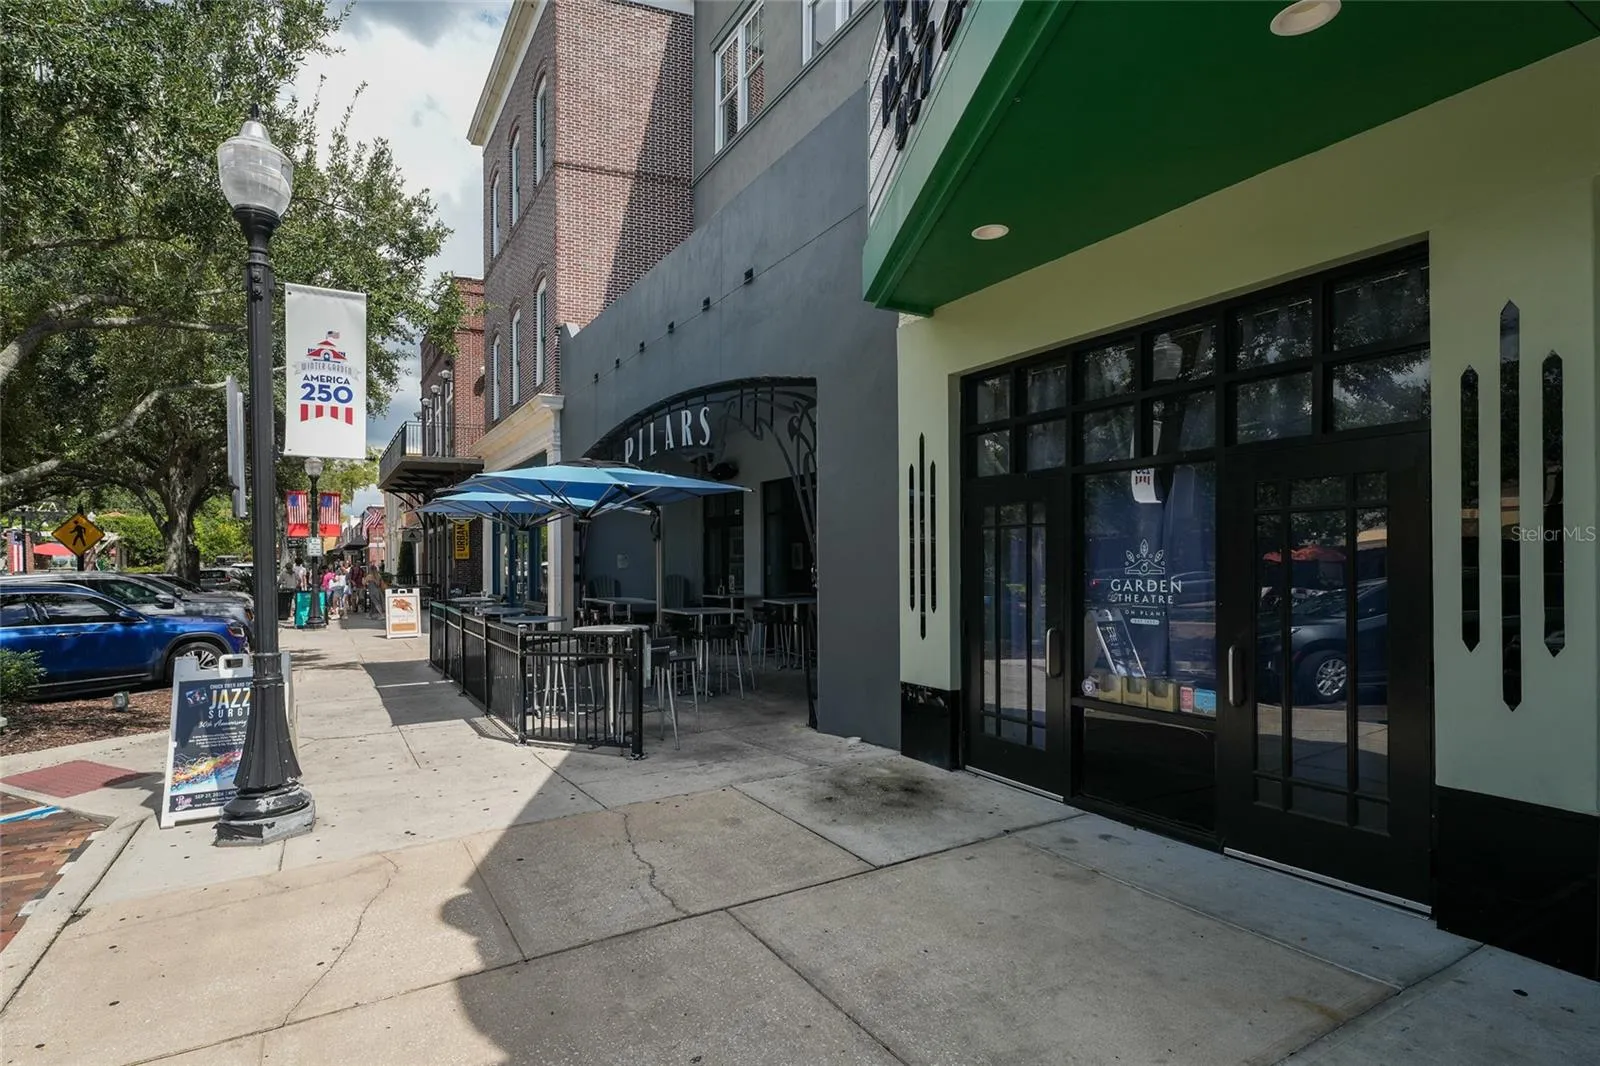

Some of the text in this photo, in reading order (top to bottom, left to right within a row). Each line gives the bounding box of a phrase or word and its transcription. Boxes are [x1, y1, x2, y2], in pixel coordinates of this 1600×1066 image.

[301, 362, 352, 375] WINTER GARDEN
[302, 374, 350, 385] AMERICA
[300, 383, 353, 404] 250
[625, 406, 711, 463] PILARS
[456, 524, 466, 552] URBAN
[1110, 578, 1182, 593] GARDEN
[1118, 594, 1174, 604] THEATRE
[208, 687, 251, 710] JAZZ
